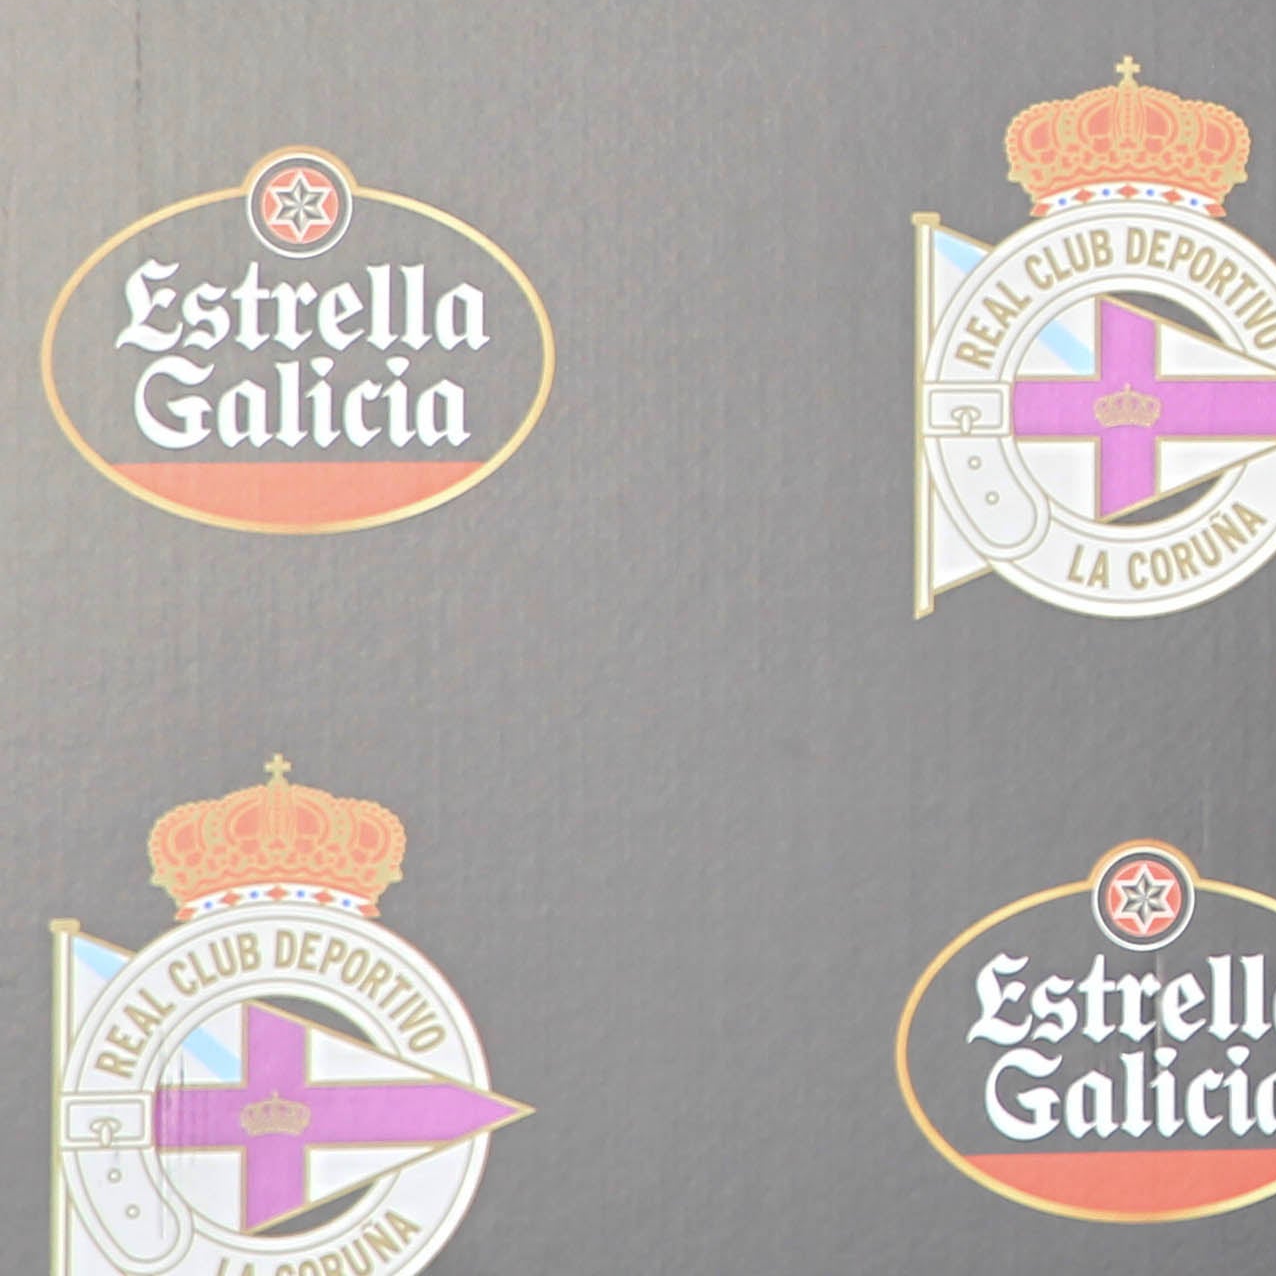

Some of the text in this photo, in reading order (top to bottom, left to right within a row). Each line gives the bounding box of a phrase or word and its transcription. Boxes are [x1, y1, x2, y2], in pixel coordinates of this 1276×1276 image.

[115, 259, 490, 352] Estrella
[955, 280, 1034, 370] REAL
[1023, 228, 1114, 290] CLUB
[134, 355, 471, 449] Galicia
[1067, 501, 1268, 591] LA CORUÑA
[96, 929, 446, 1079] REAL CLUB DEPORTIVO
[275, 1209, 422, 1276] RUÑA
